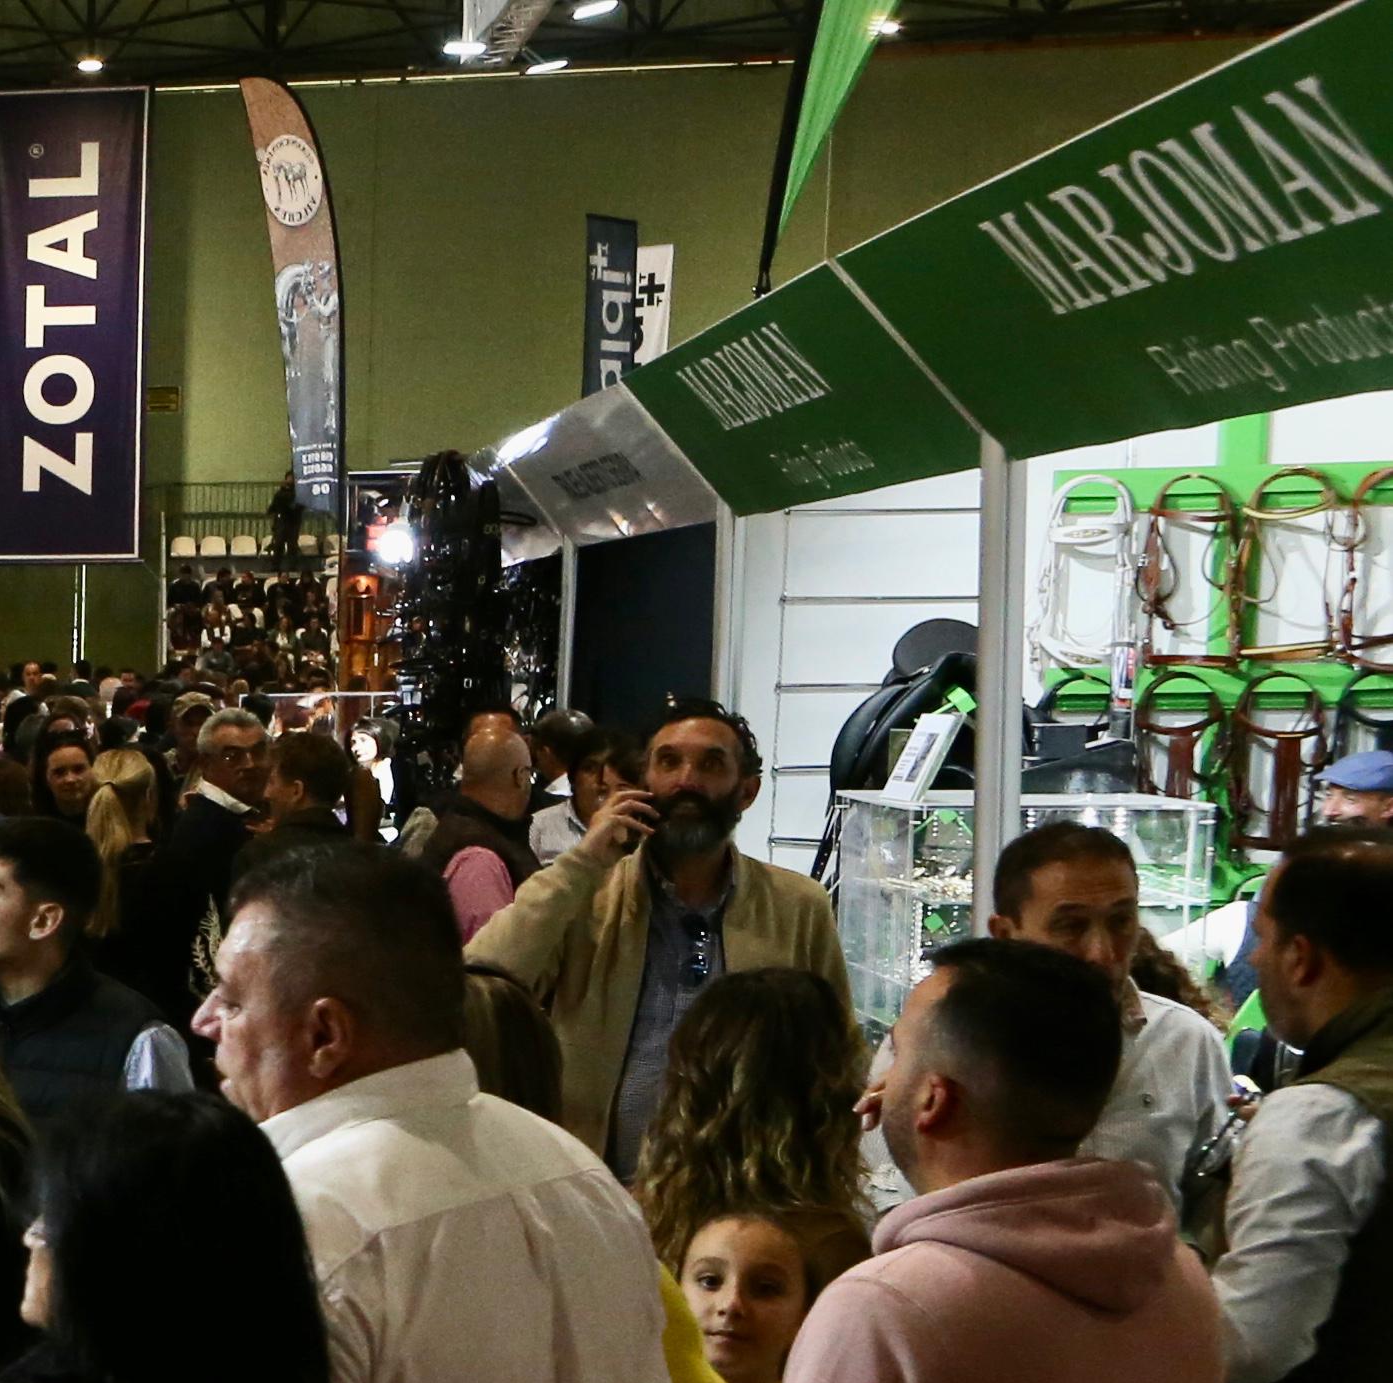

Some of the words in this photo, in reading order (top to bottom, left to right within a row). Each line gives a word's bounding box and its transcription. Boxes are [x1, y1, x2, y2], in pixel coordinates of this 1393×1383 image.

[978, 76, 1393, 314] MARJOMAN
[23, 142, 100, 495] ZOTAL
[675, 321, 833, 430] MARJOMAN
[1146, 336, 1286, 394] Riding
[1248, 295, 1393, 372] Product
